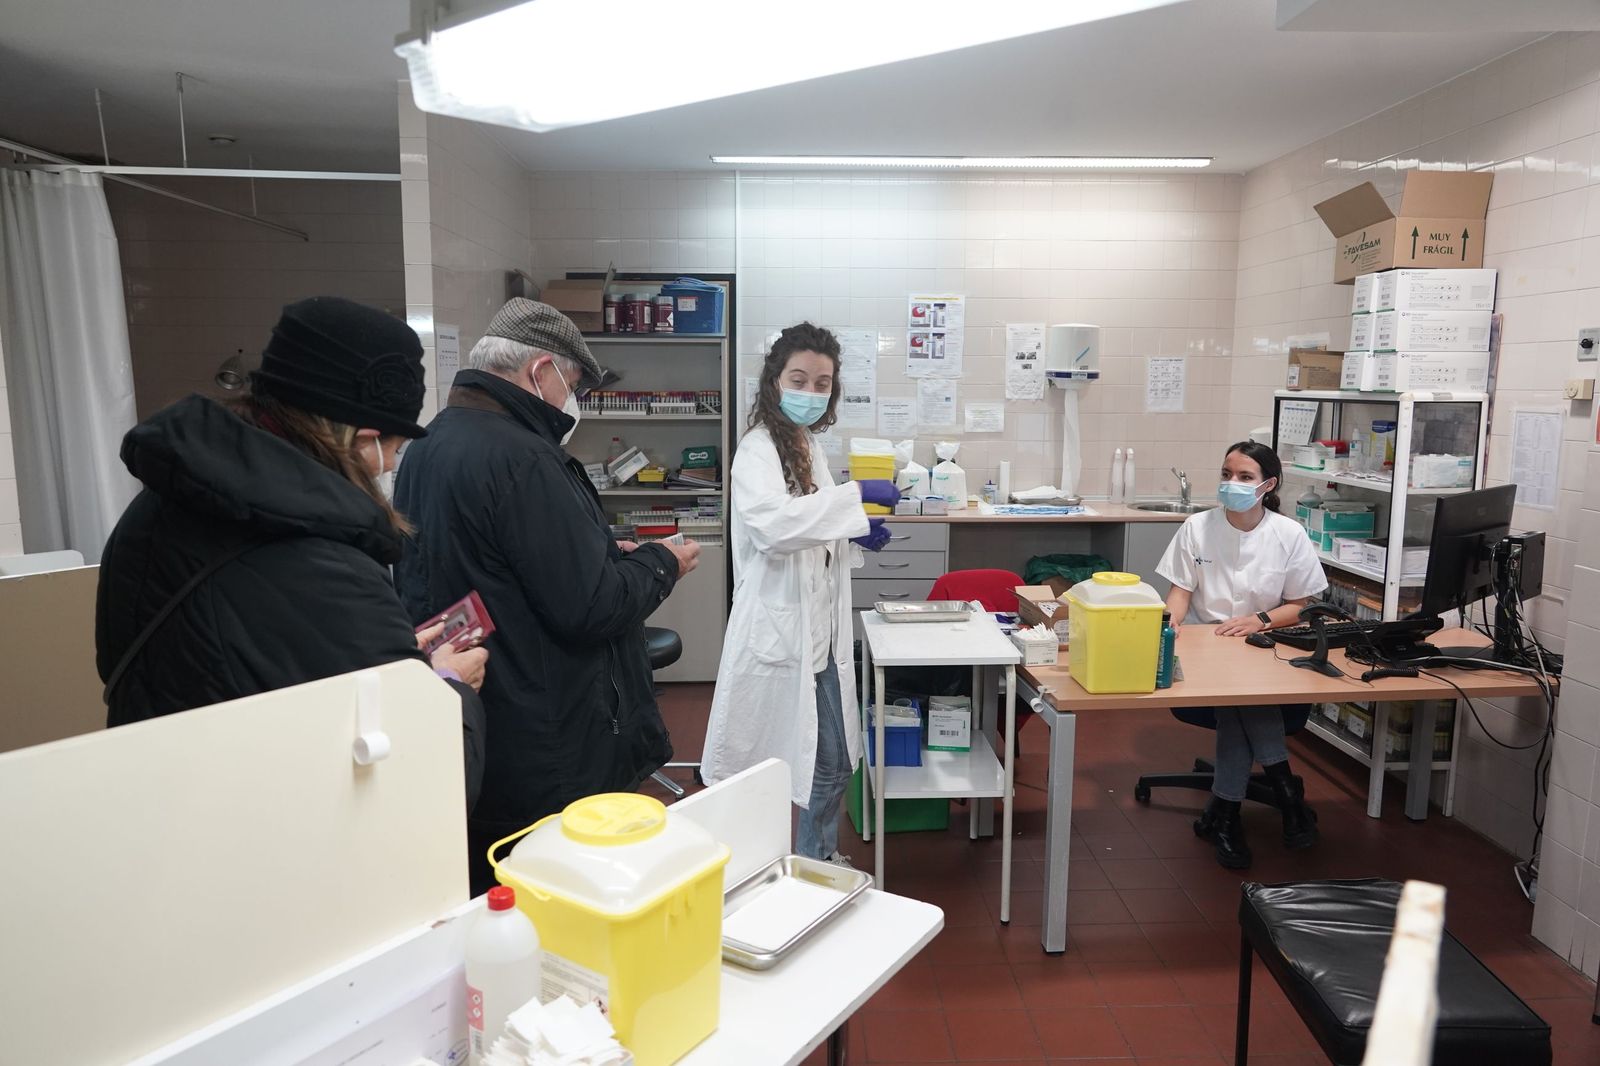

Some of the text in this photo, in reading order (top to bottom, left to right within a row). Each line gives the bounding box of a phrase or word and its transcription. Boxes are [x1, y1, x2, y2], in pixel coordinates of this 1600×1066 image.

[1429, 232, 1451, 241] MUY
[1347, 238, 1381, 255] FAVESAM
[1423, 244, 1455, 255] FRÁGIL
